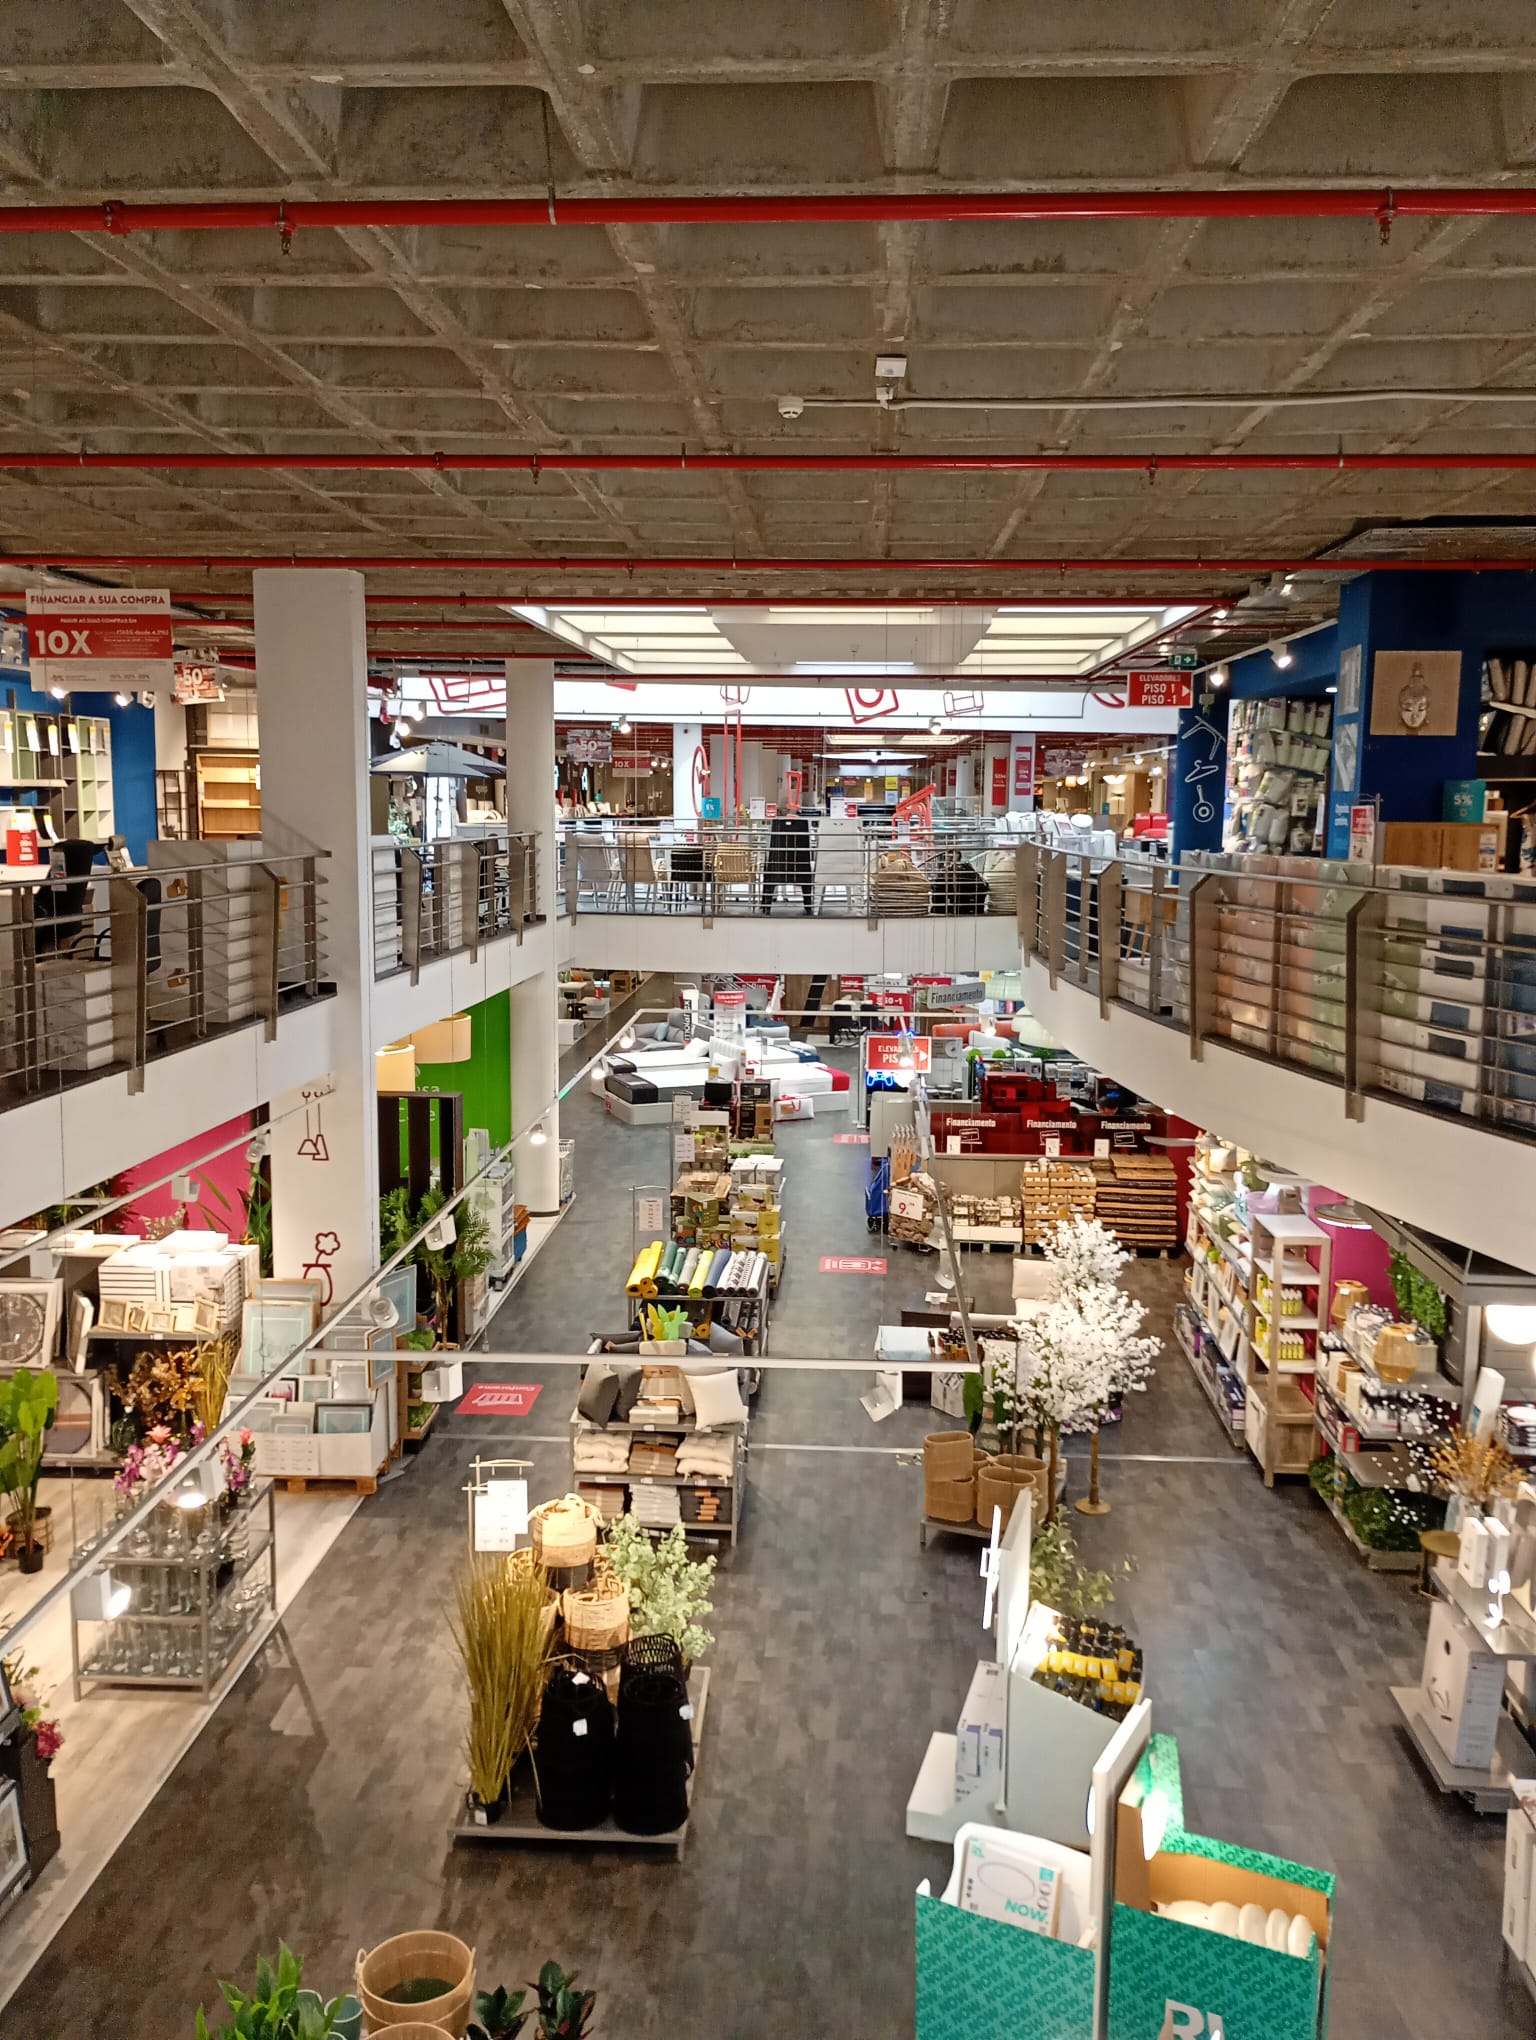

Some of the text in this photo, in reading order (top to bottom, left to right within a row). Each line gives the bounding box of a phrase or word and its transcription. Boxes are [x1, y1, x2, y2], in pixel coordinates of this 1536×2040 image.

[30, 595, 166, 605] FINANCIAR A SUA COMPRA
[34, 630, 93, 655] 10X
[1144, 683, 1175, 693] PISO 1
[1141, 694, 1177, 705] PISO -1
[614, 760, 630, 768] 10X
[930, 990, 983, 1004] Financiamento
[945, 1117, 996, 1128] Financiamento
[1026, 1119, 1077, 1130] Financiamento
[1100, 1120, 1152, 1131] Financiamento
